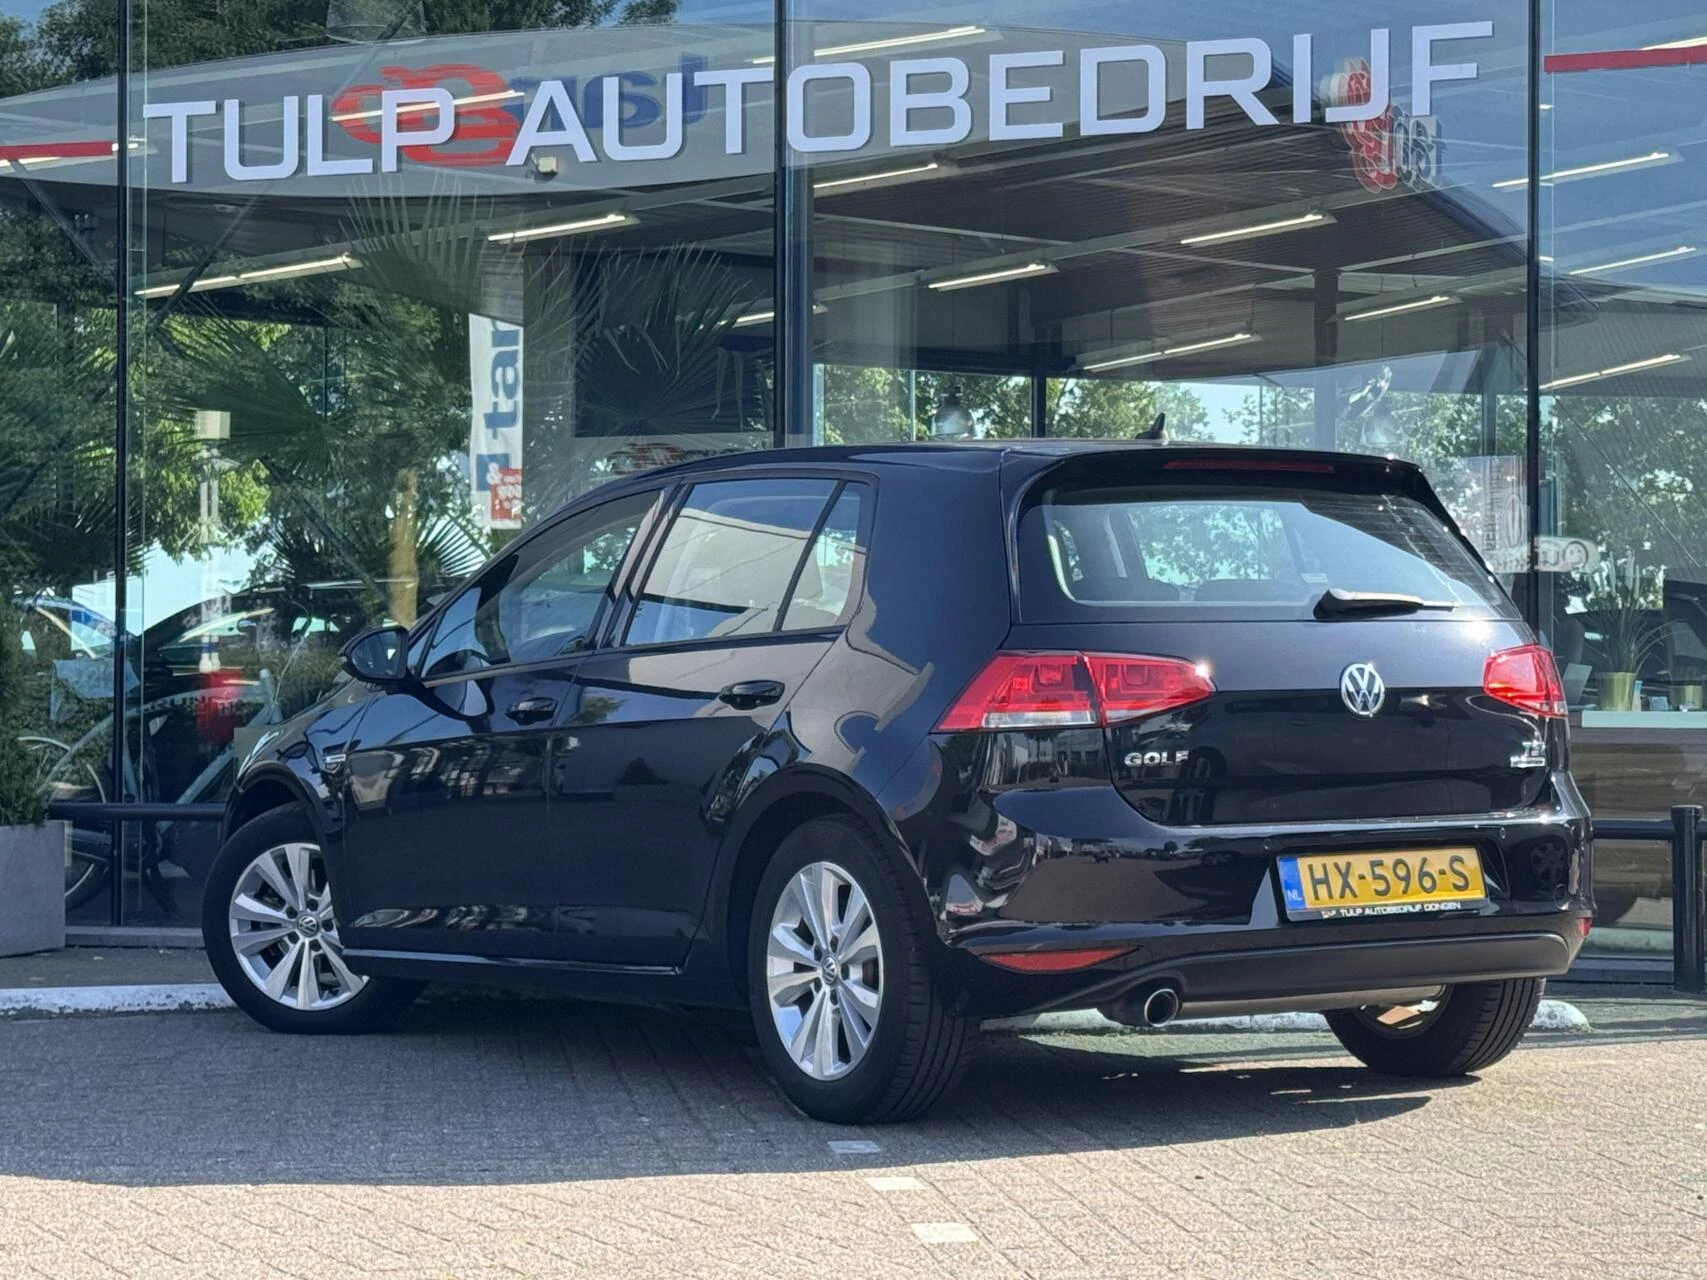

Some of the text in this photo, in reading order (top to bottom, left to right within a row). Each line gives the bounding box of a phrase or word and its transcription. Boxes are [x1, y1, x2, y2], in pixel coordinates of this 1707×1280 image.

[143, 88, 456, 183] TULP
[505, 20, 1494, 166] AUTOBEDRIJF
[1124, 750, 1189, 767] GOLF
[1307, 855, 1470, 901] HX-596-S
[1286, 889, 1302, 901] NL
[1340, 908, 1363, 918] TULP
